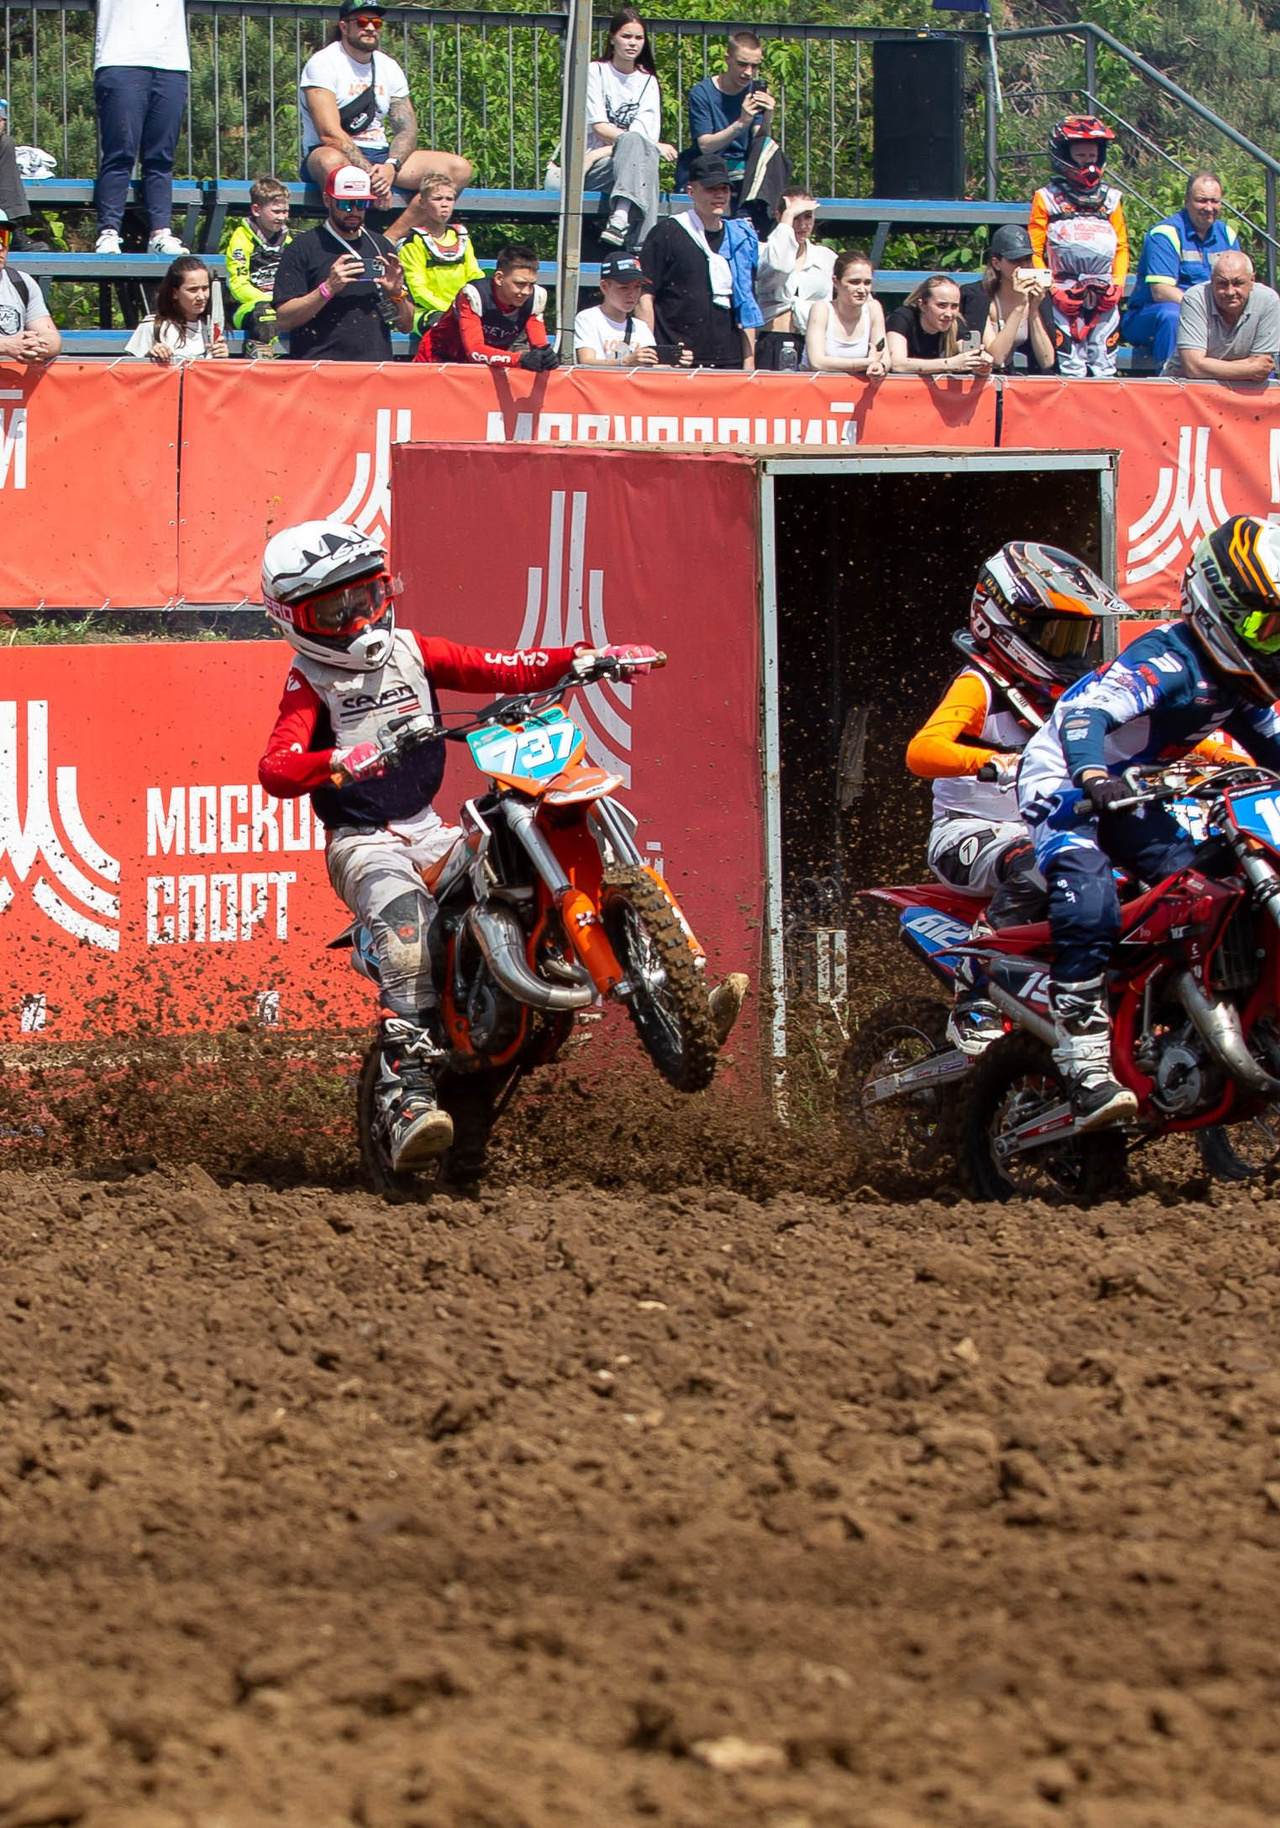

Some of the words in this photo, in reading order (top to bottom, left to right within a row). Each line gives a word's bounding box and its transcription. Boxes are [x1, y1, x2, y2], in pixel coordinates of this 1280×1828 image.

[1199, 555, 1250, 620] 100%
[486, 722, 576, 776] 737
[146, 784, 327, 856] МОСКО
[146, 871, 297, 945] СПОРТ
[906, 913, 972, 949] 612
